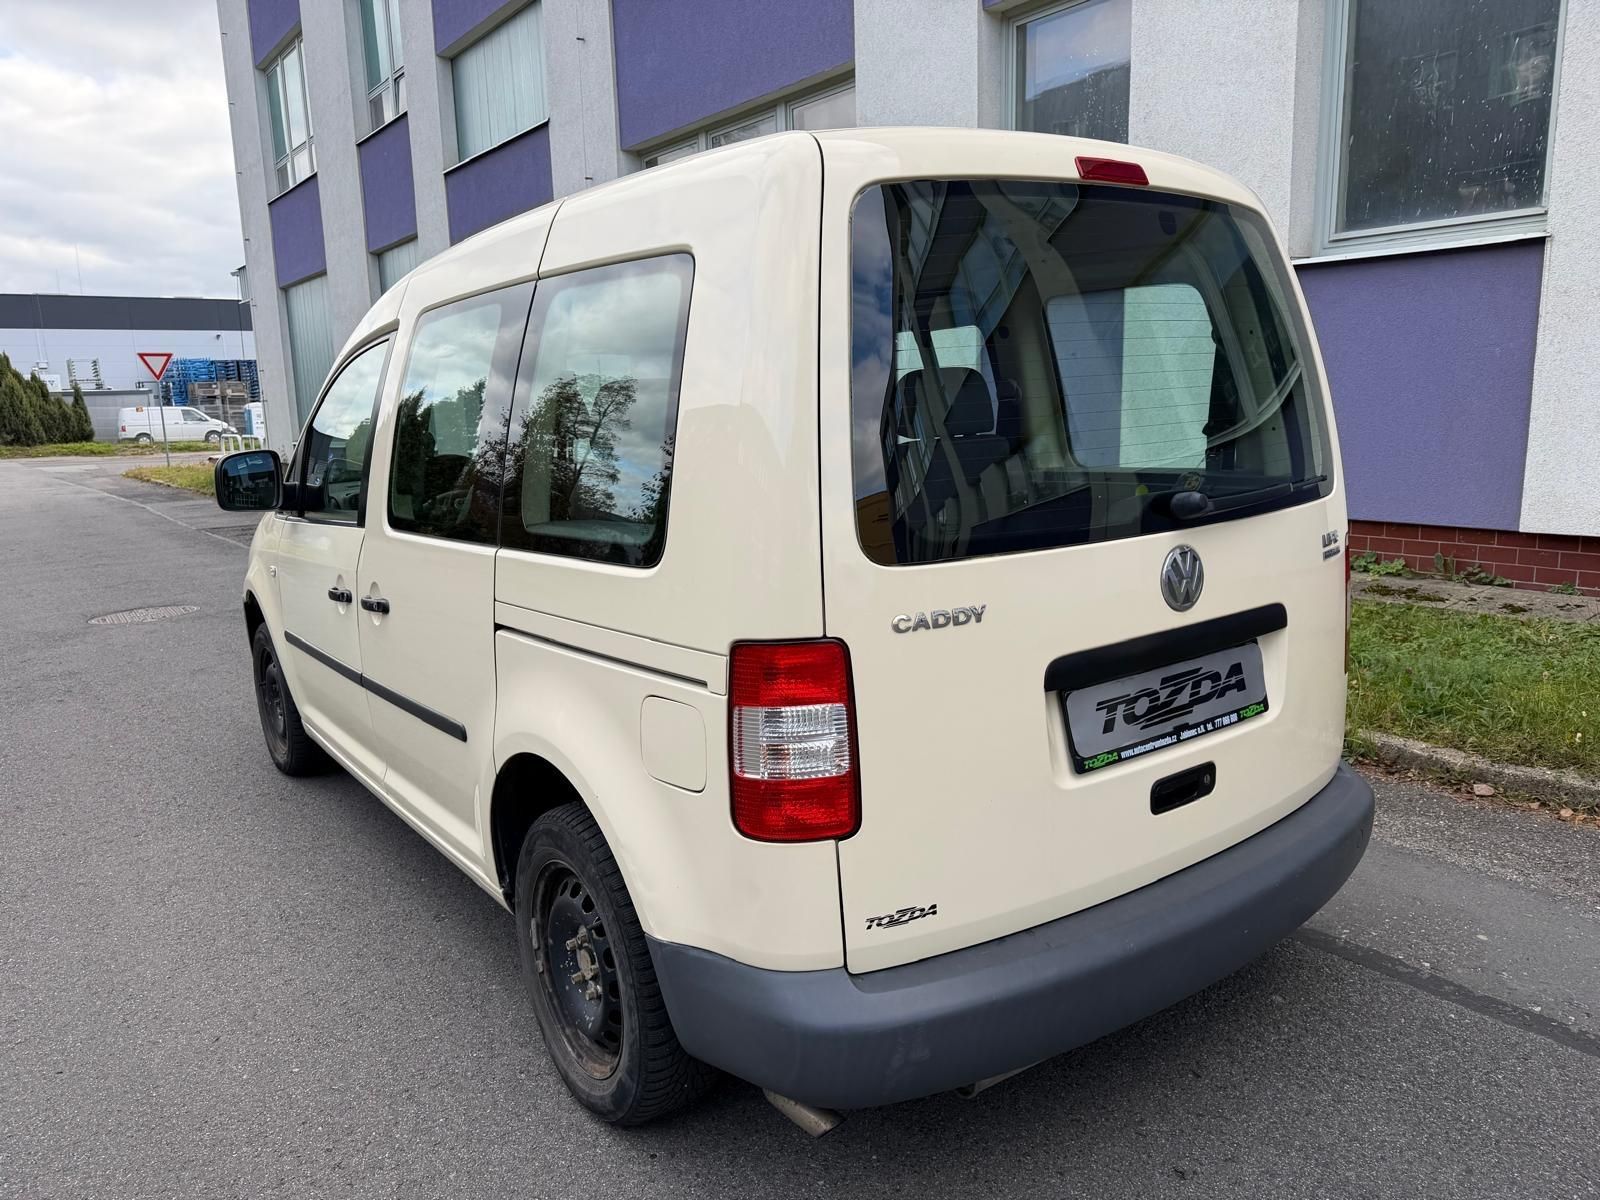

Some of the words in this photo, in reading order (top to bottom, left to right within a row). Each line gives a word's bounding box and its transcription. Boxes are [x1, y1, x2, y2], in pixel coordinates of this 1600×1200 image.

[891, 604, 986, 633] CADDY
[1096, 662, 1246, 735] TOZDA
[865, 903, 937, 930] TOZDA
